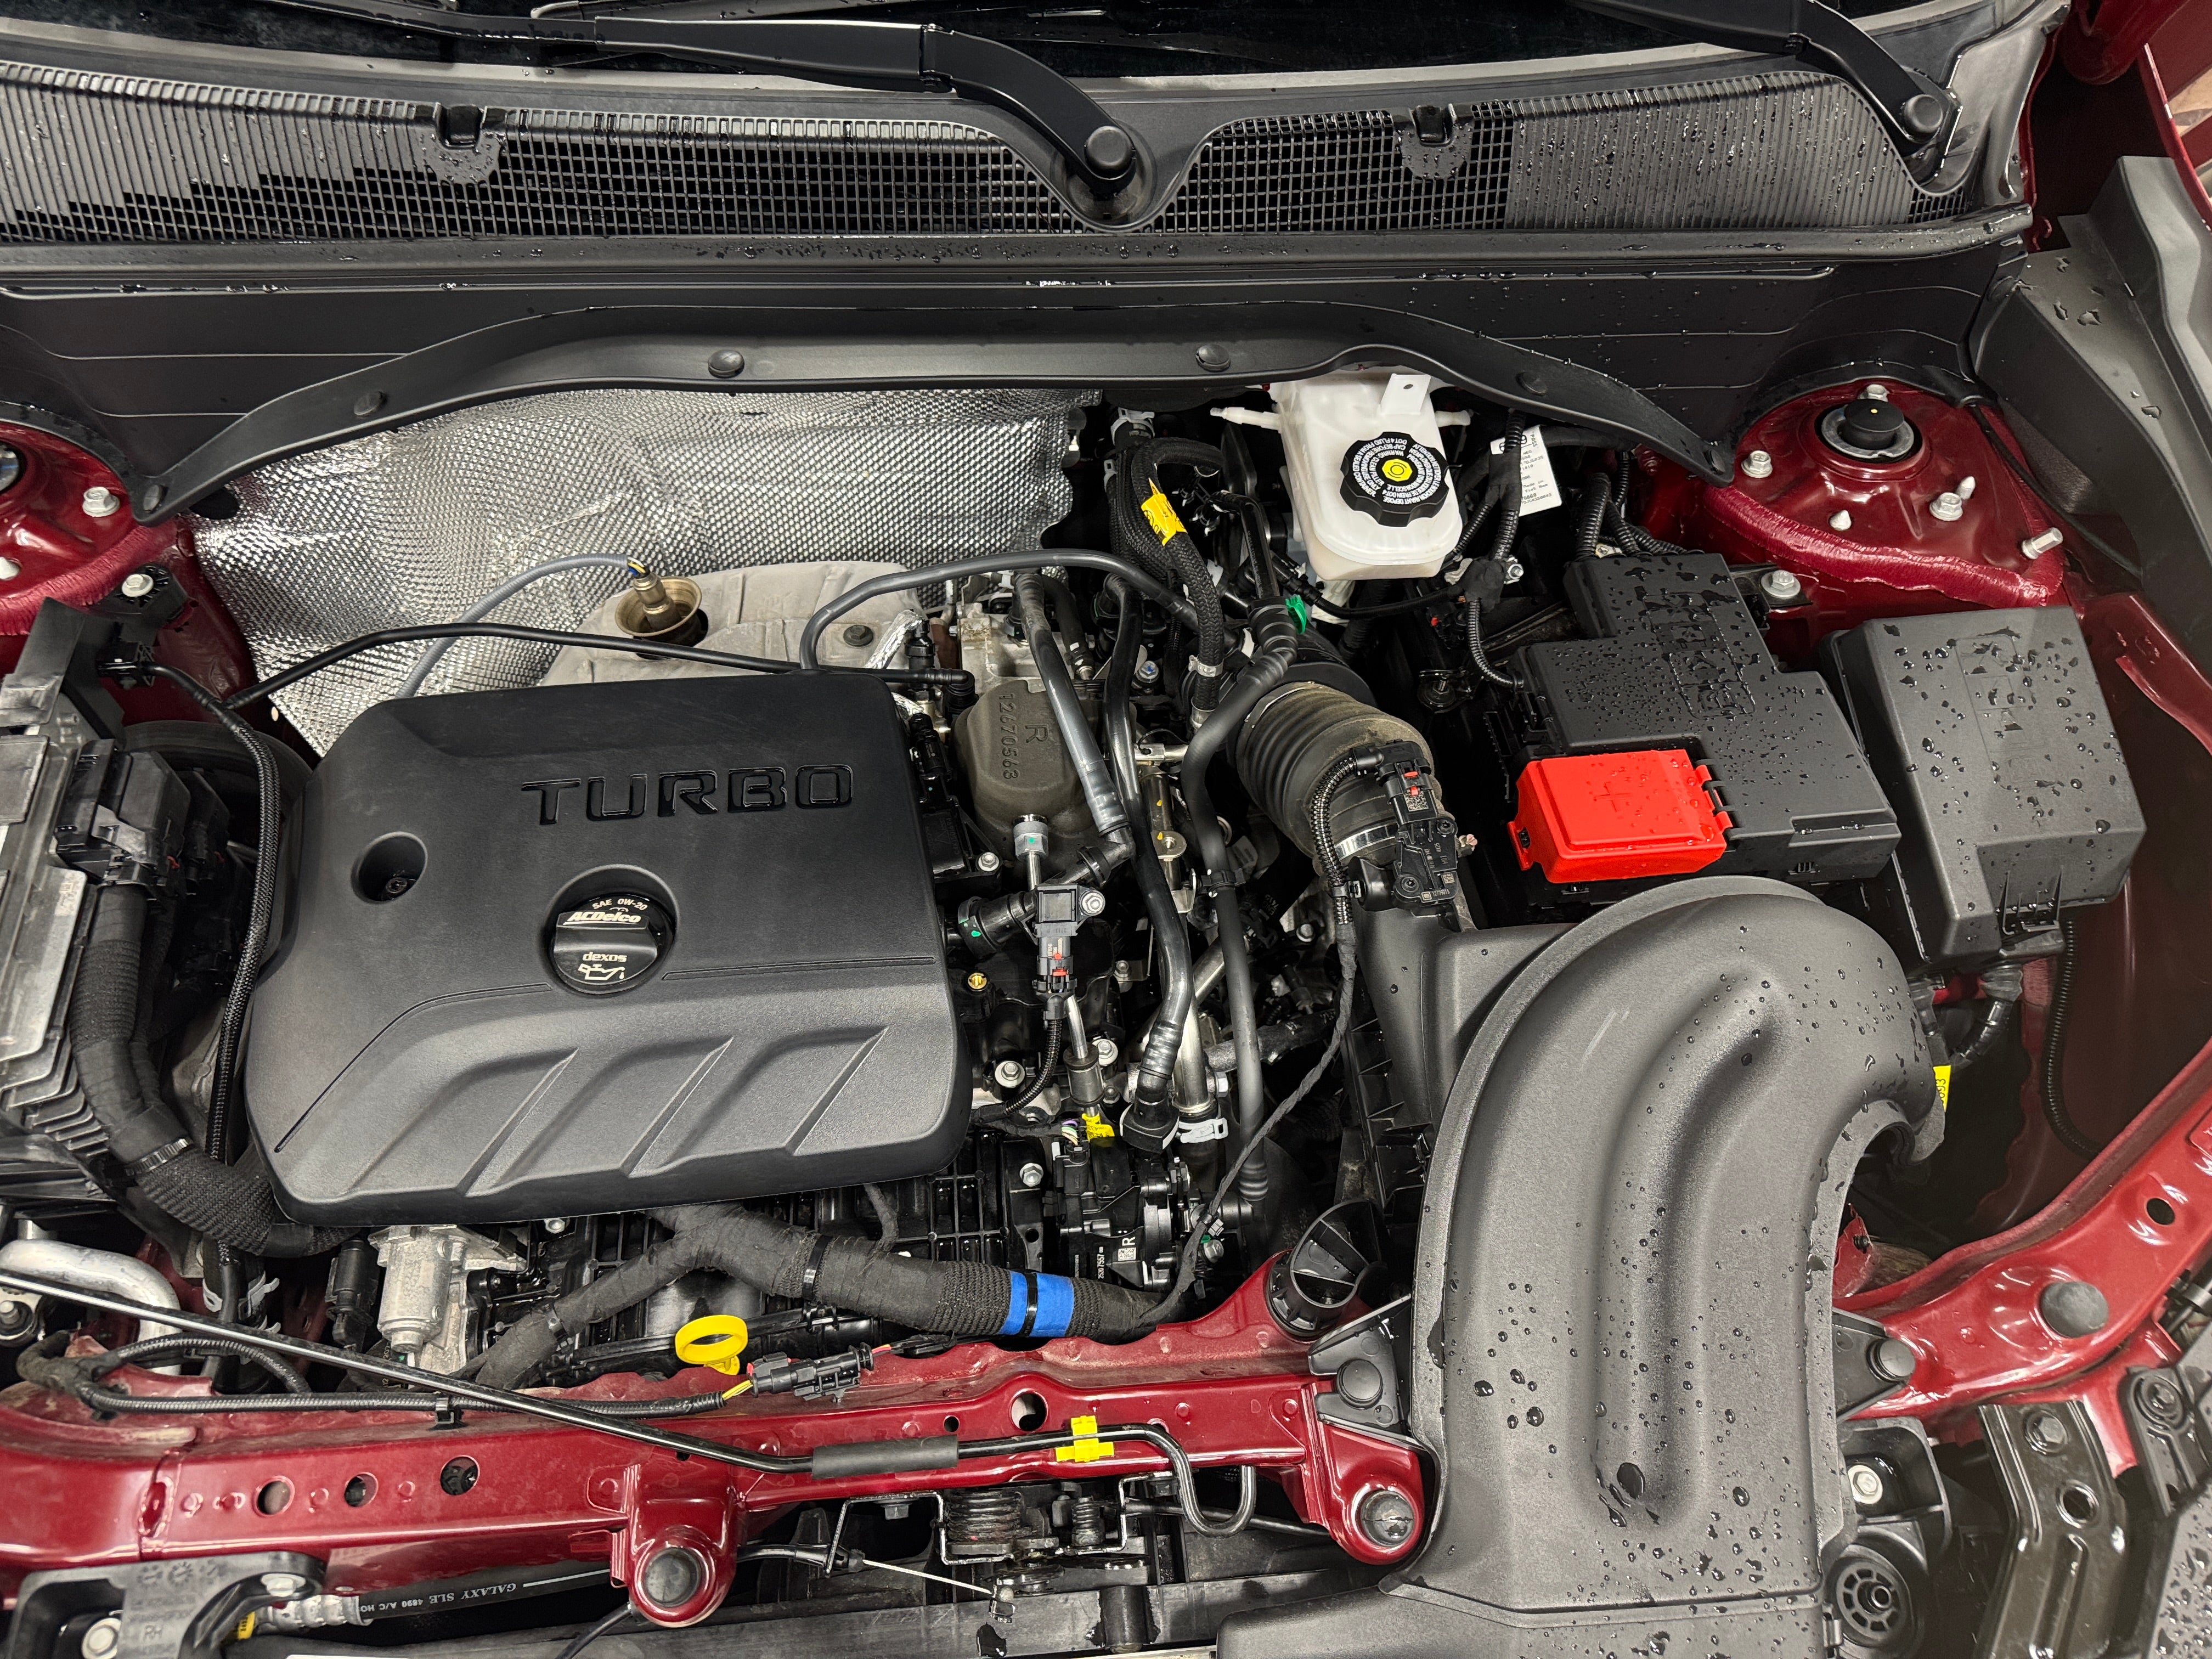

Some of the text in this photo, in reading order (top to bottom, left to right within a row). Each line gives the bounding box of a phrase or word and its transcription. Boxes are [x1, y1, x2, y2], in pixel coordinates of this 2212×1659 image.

[1359, 442, 1375, 454] FROM
[1371, 443, 1393, 454] BEFORE
[1352, 454, 1362, 472] SEALED
[1369, 456, 1380, 471] CLEAN
[1367, 479, 1381, 491] ONLY
[1369, 471, 1385, 487] FILLER
[998, 693, 1019, 780] 12670563
[1025, 724, 1049, 743] R
[521, 764, 854, 826] TURBO
[592, 898, 648, 911] SAE 0W-20
[567, 911, 641, 923] ACDelco
[582, 952, 628, 962] dexos
[1121, 1236, 1136, 1246] R
[461, 1582, 517, 1601] GALAXY
[401, 1598, 424, 1608] 4890
[429, 1592, 455, 1605] SLE
[379, 1601, 397, 1611] A/C
